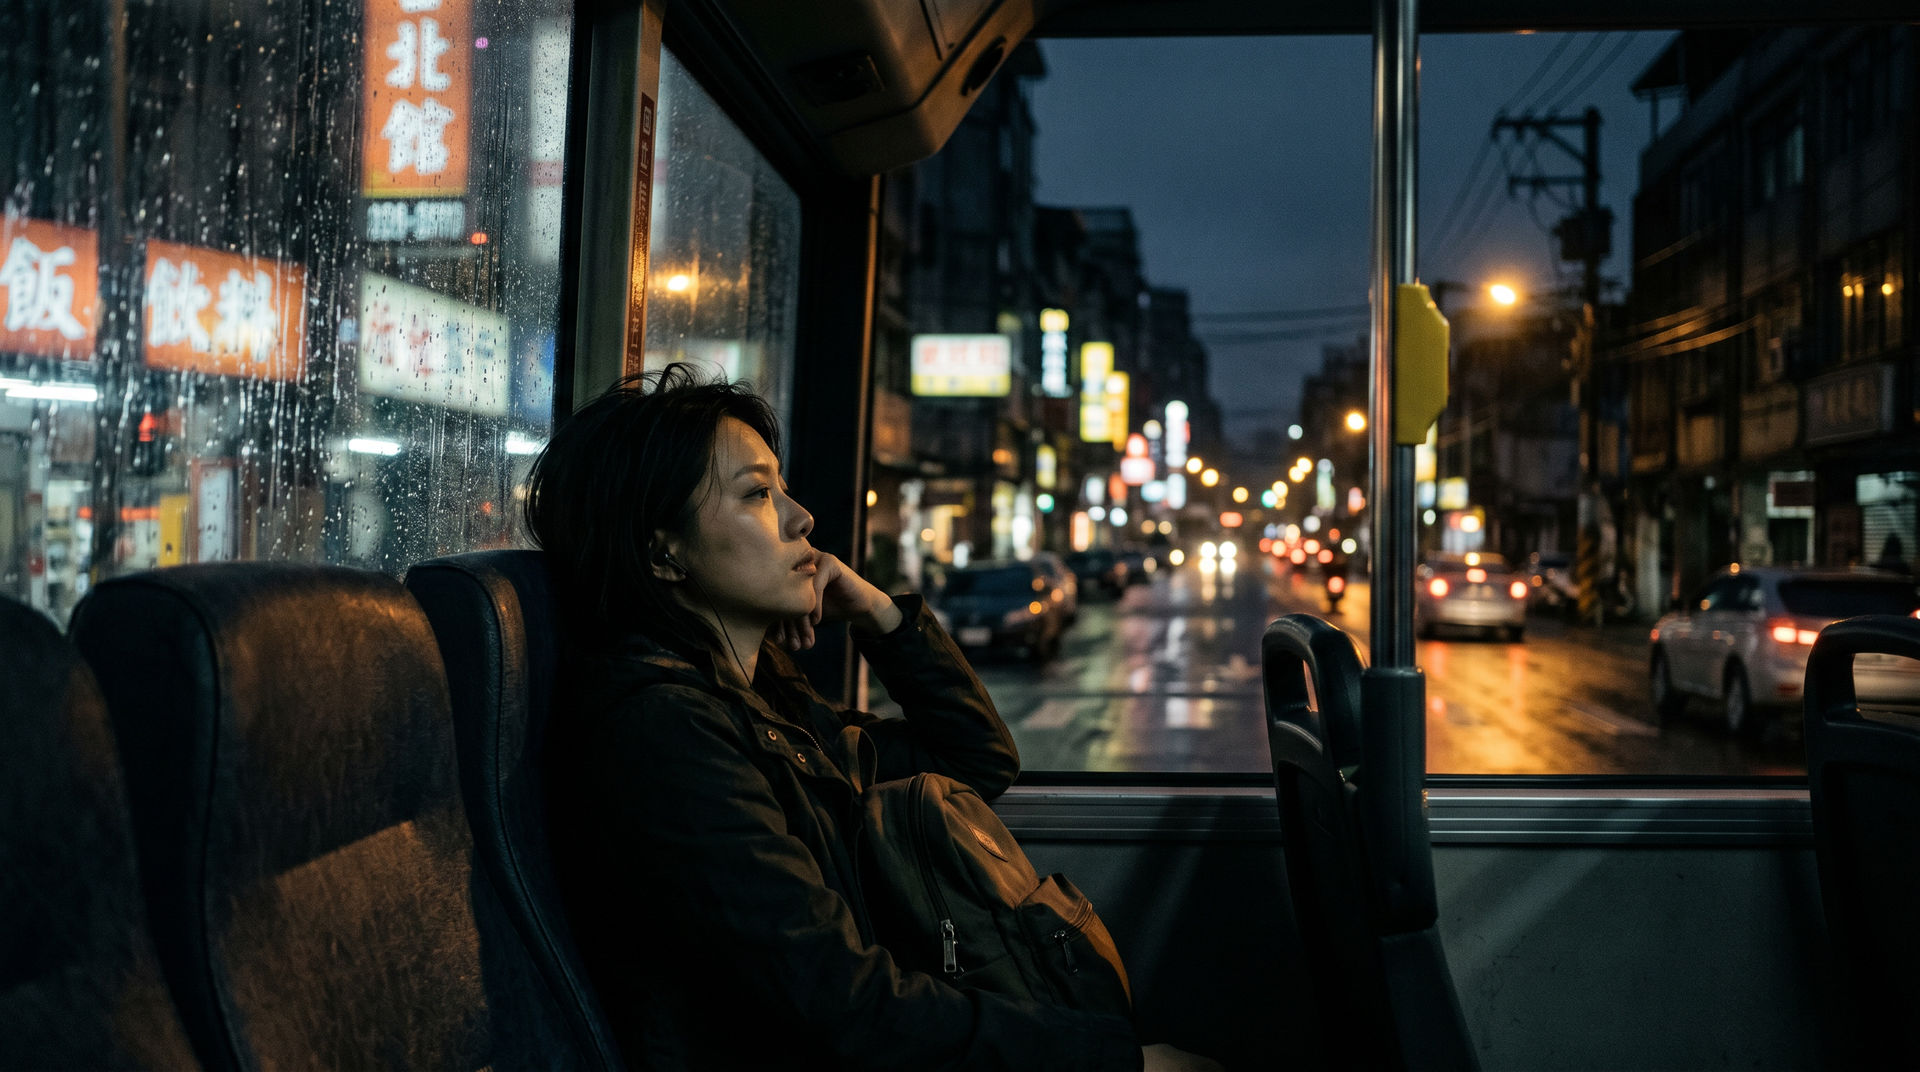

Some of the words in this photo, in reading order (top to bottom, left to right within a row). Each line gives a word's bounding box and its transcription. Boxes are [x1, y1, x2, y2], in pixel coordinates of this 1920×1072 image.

[381, 0, 455, 175] 北館
[0, 236, 86, 340] 飯
[148, 257, 276, 363] 飲料
